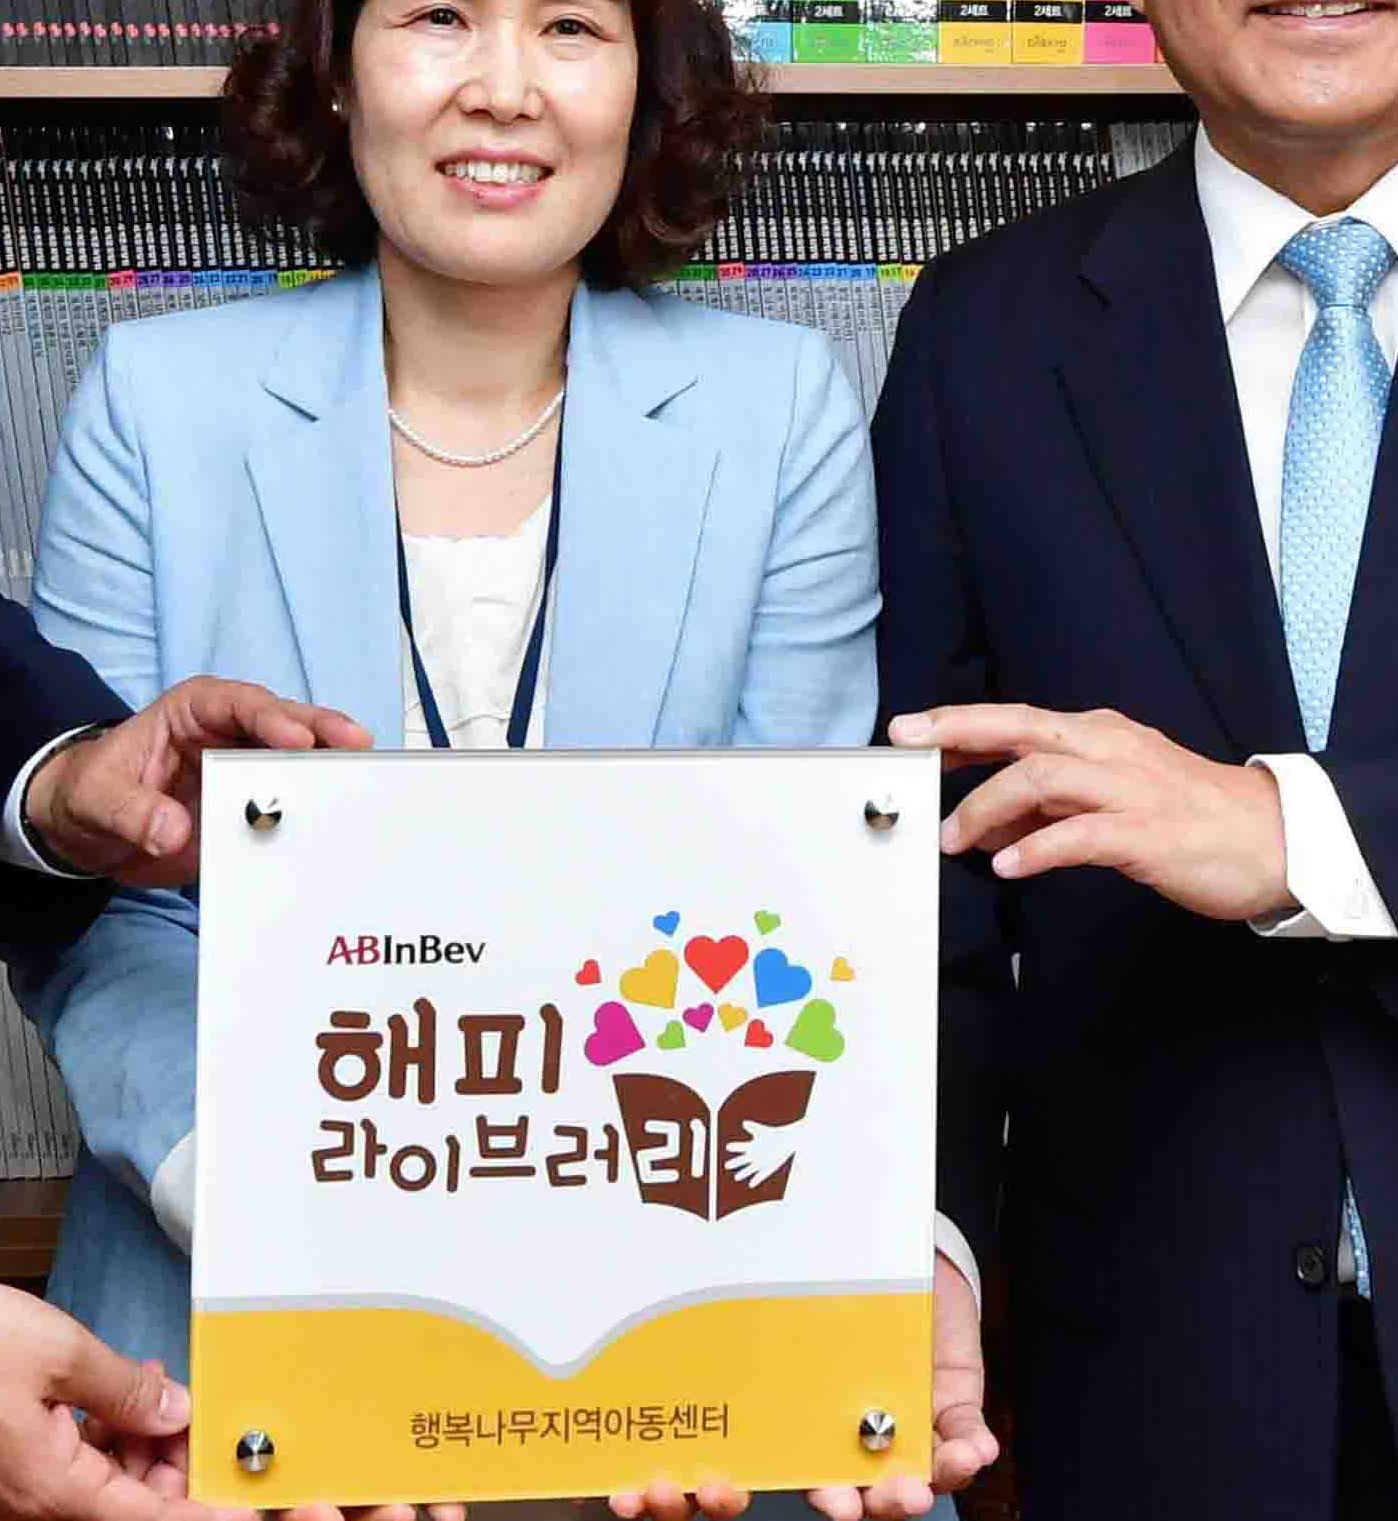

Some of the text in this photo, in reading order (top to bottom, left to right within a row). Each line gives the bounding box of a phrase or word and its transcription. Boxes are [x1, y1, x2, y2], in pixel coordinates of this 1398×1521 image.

[325, 933, 487, 967] ABInBev
[315, 996, 564, 1106] 해피
[310, 1114, 706, 1195] 라이브러리
[408, 1402, 731, 1452] 행복나무지역아동센터
